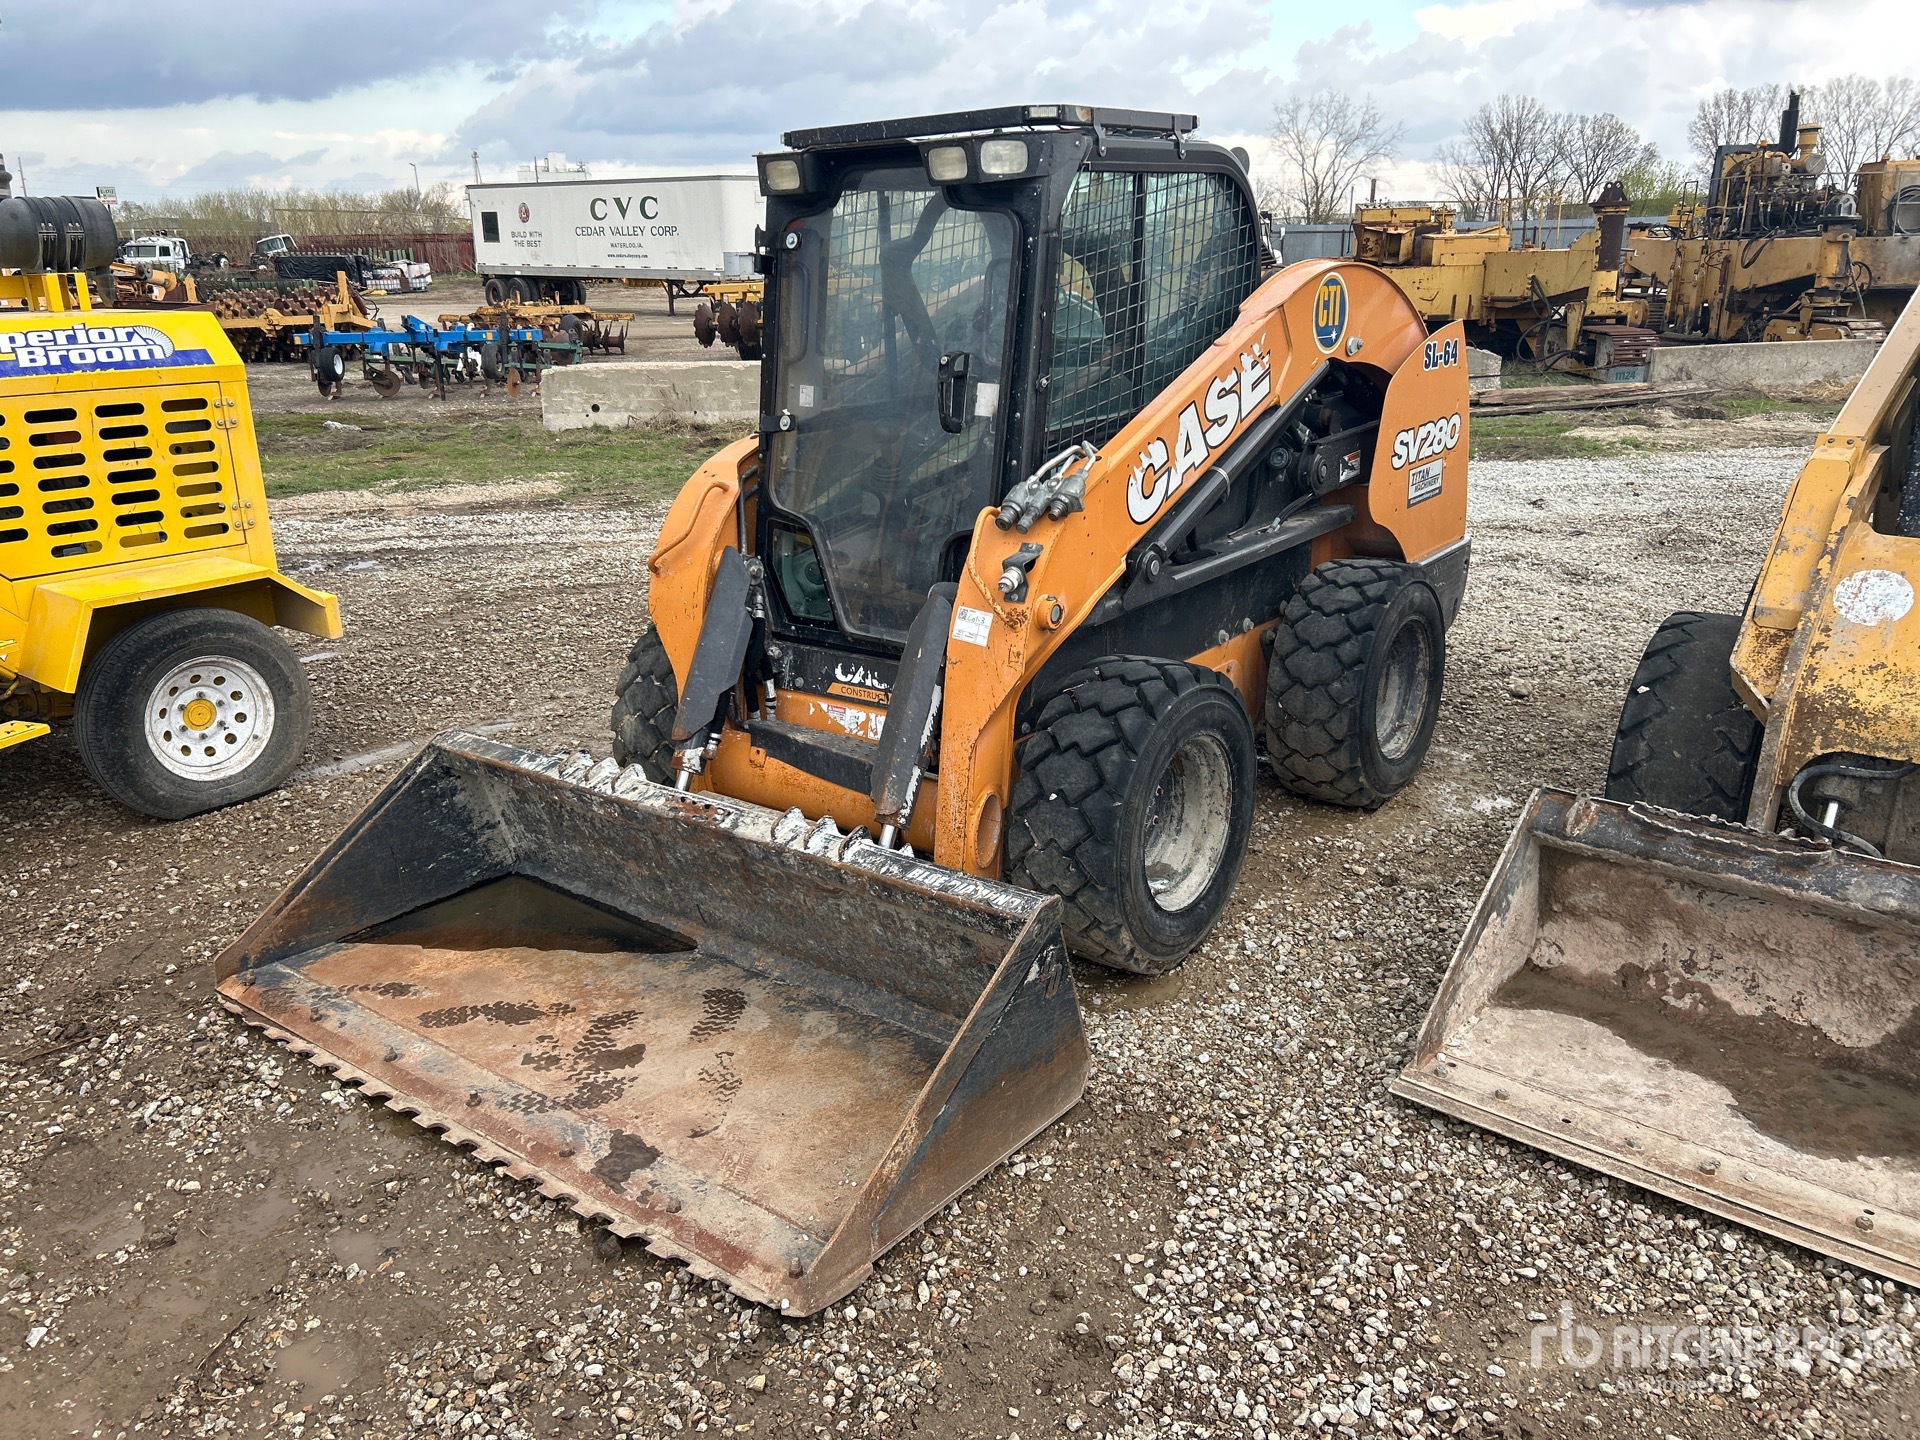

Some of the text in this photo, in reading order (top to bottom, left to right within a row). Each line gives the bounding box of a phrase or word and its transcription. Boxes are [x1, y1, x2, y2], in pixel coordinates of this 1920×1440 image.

[575, 225, 680, 237] CEDAR VALLEY CORP.
[514, 240, 542, 248] THE BEST
[1317, 285, 1342, 328] CTI
[14, 343, 166, 368] Broom
[1422, 337, 1459, 372] SL-64
[1615, 370, 1637, 381] 11124
[1126, 340, 1272, 526] CASE
[1390, 412, 1462, 471] SV280
[1410, 466, 1432, 487] TITAN
[1413, 475, 1441, 494] MACHINERY
